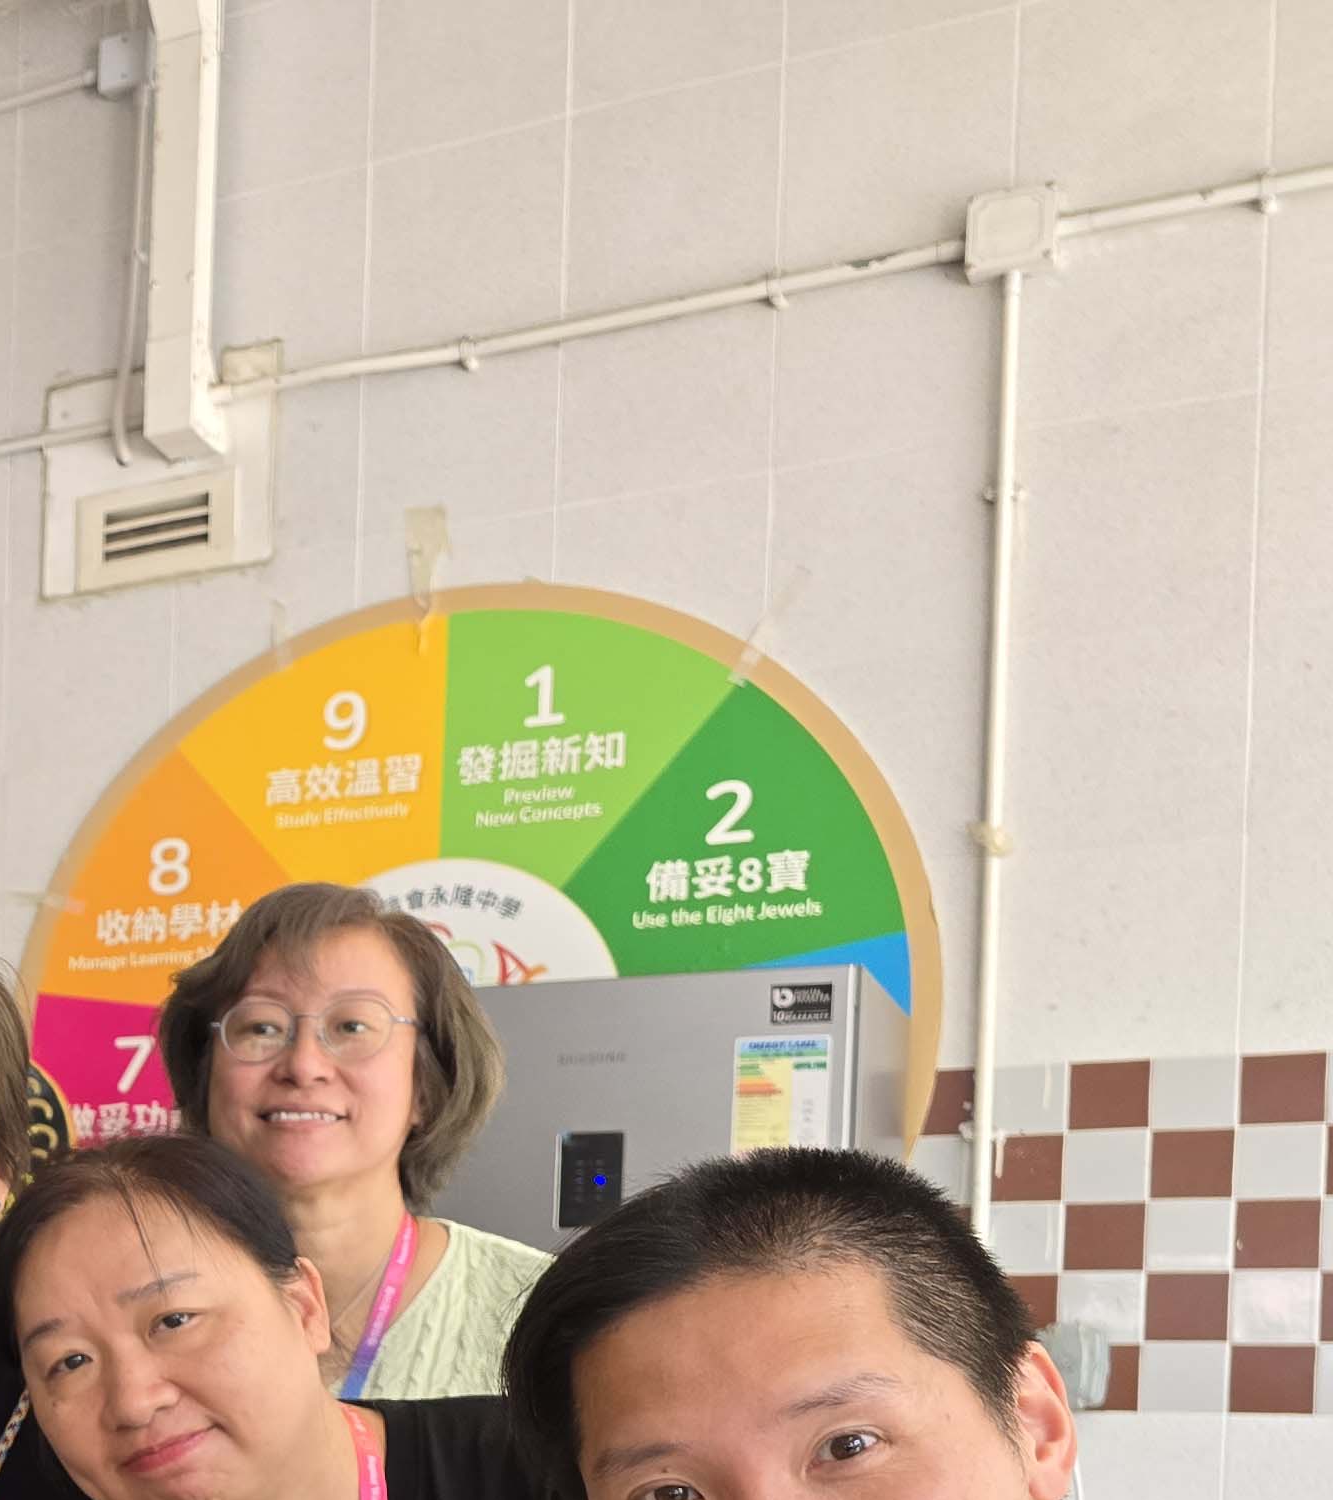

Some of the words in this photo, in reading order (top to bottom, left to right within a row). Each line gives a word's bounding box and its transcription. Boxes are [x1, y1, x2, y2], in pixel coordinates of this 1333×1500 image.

[322, 691, 367, 751] 9
[524, 665, 565, 727] 1
[458, 731, 627, 785] 發掘新知
[275, 811, 320, 829] Study
[324, 802, 409, 824] Effectively
[475, 811, 515, 828] New
[520, 802, 603, 823] Concepts
[503, 784, 575, 805] Preview
[704, 779, 755, 845] 2
[148, 837, 191, 896] 8
[646, 851, 811, 903] 備妥8寶
[633, 911, 667, 929] Use
[671, 908, 702, 927] the
[706, 904, 754, 926] Eight
[757, 899, 821, 921] Jewels
[114, 1035, 156, 1093] 7
[70, 1100, 182, 1139] 做妥功
